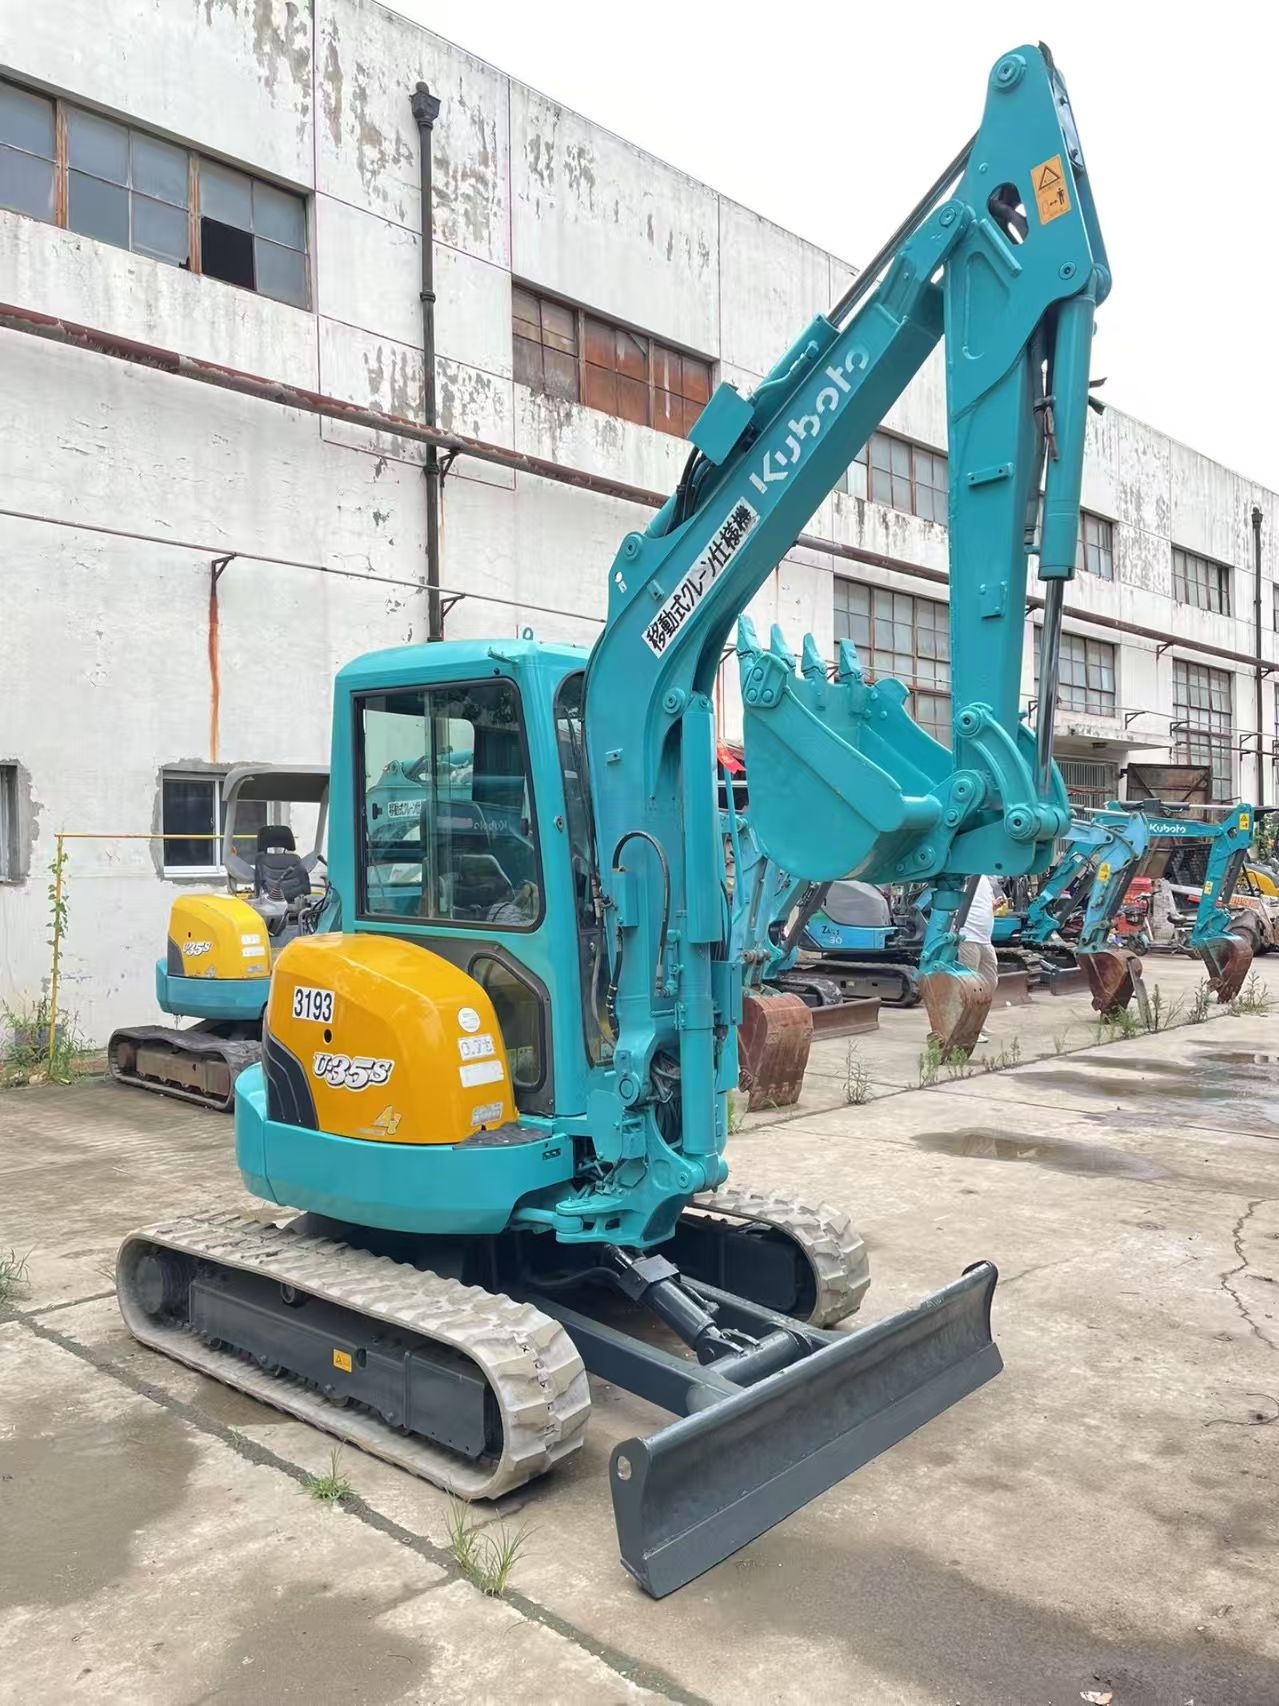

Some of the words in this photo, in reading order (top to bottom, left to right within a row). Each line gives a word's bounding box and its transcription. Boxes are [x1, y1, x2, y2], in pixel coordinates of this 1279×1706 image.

[749, 347, 870, 494] Kubota
[646, 504, 754, 652] 移動式クレーン仕様機
[1149, 823, 1187, 834] Kubota
[829, 936, 843, 944] 30
[294, 988, 332, 1022] 3193
